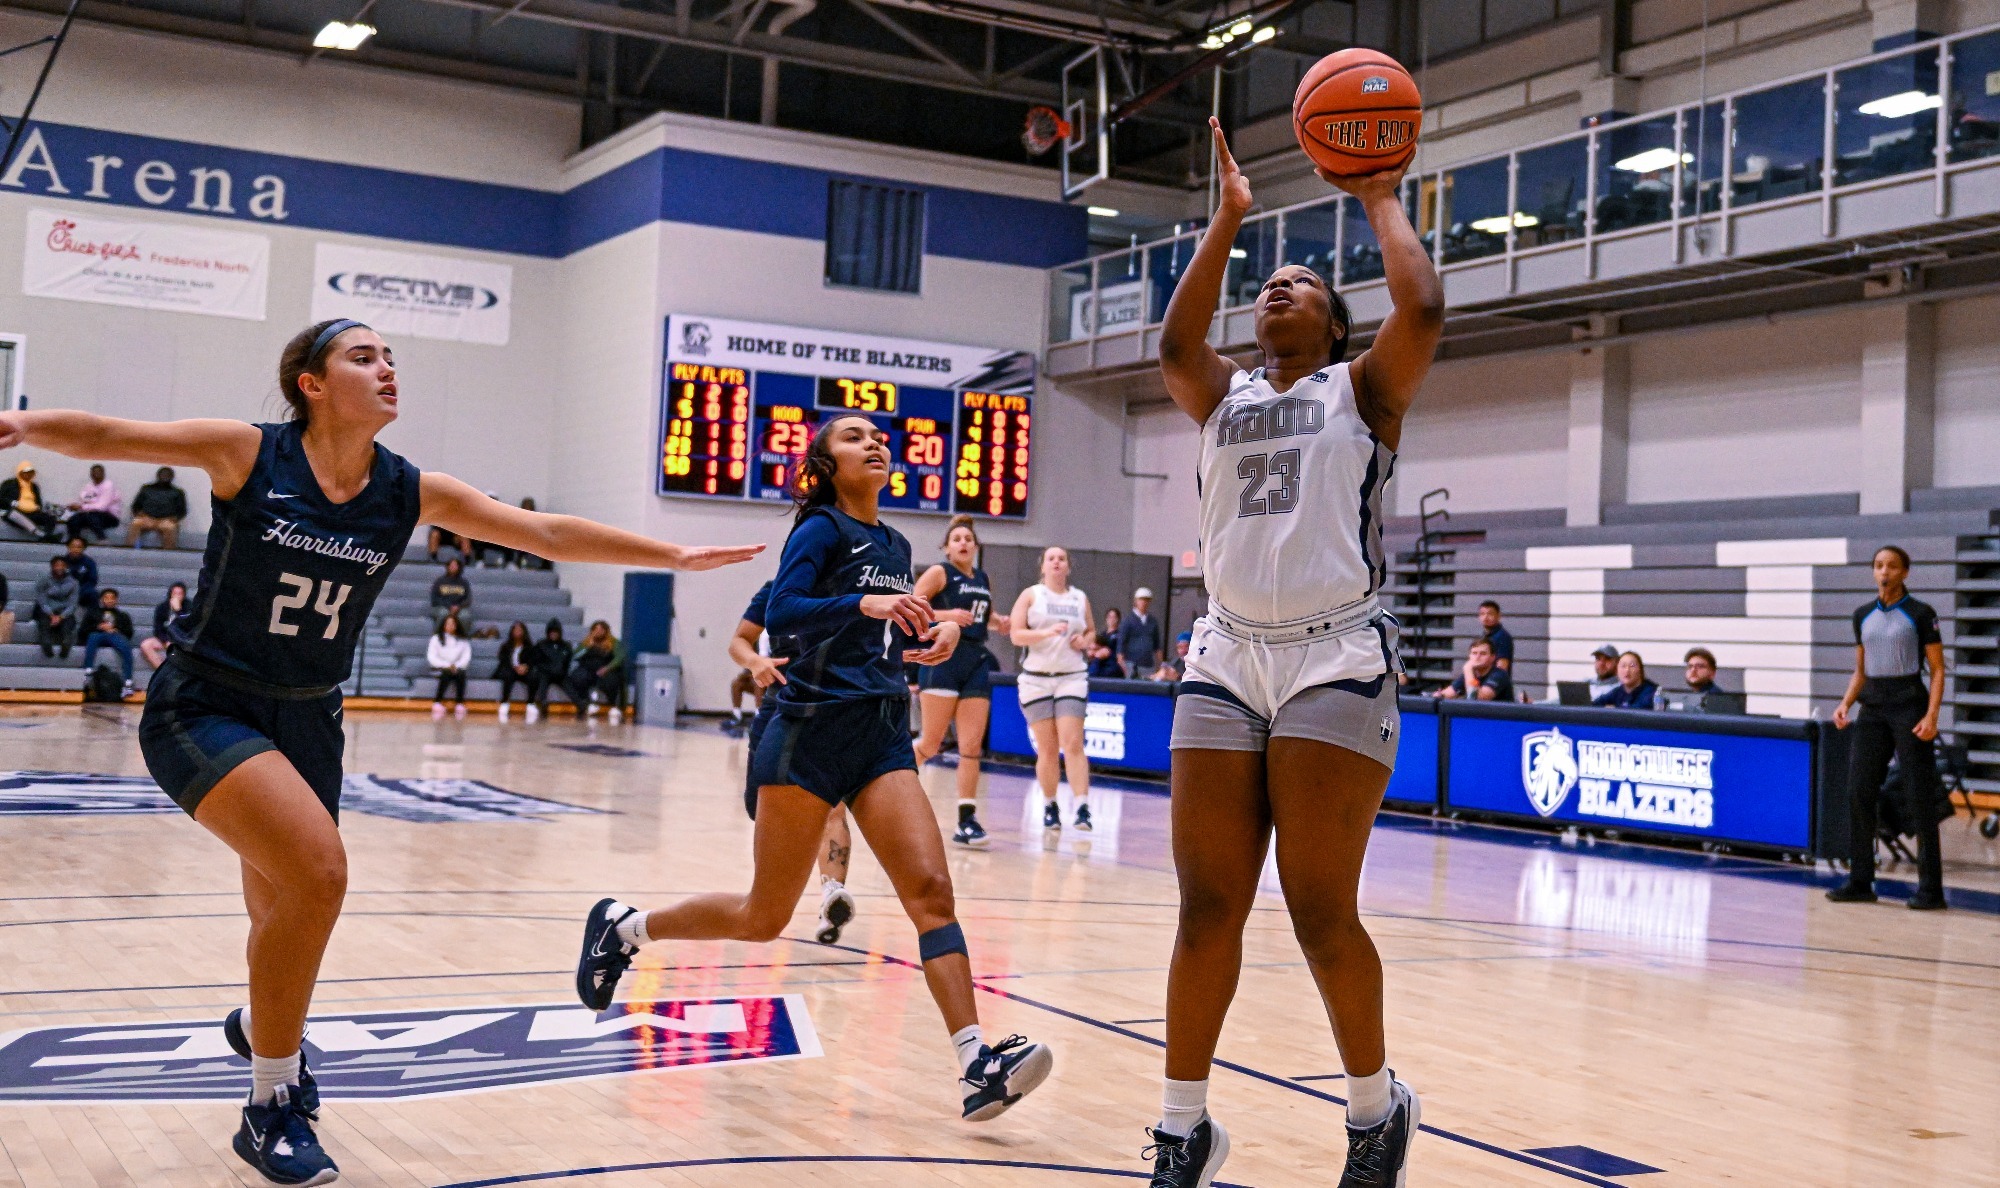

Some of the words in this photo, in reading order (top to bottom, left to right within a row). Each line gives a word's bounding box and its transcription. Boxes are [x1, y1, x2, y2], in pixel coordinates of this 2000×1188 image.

[1363, 83, 1387, 92] MAC
[1325, 120, 1367, 149] THE
[1375, 119, 1416, 149] ROCK
[0, 127, 289, 220] Arena
[150, 252, 210, 269] Frederick
[214, 260, 249, 273] North
[353, 273, 474, 300] ACTIVE
[727, 335, 787, 356] HOME
[792, 343, 816, 359] OF
[821, 344, 861, 364] THE
[867, 350, 952, 373] BLAZERS
[684, 382, 694, 399] 1
[707, 383, 721, 402] 2
[734, 386, 748, 405] 2
[837, 378, 896, 412] 7:57
[705, 402, 720, 420] 0
[732, 404, 747, 422] 0
[772, 405, 803, 423] HOOD
[974, 409, 982, 425] 1
[993, 410, 1006, 428] 0
[1217, 397, 1324, 447] HOOD
[670, 419, 692, 436] 11
[709, 422, 719, 438] 1
[770, 422, 808, 454] 23
[992, 427, 1005, 445] 0
[708, 440, 718, 456] 1
[731, 441, 746, 460] 0
[908, 434, 944, 466] 20
[991, 445, 1004, 463] 0
[1015, 447, 1028, 465] 0
[707, 459, 717, 476] 1
[773, 464, 785, 486] 1
[707, 477, 717, 494] 1
[889, 471, 907, 497] 5
[923, 474, 941, 499] 0
[990, 480, 1003, 498] 0
[1237, 449, 1300, 518] 23
[990, 497, 1002, 516] 0
[262, 519, 388, 576] Harrisburg
[269, 572, 352, 640] 24
[883, 618, 893, 660] 1
[1579, 779, 1713, 827] BLAZERS
